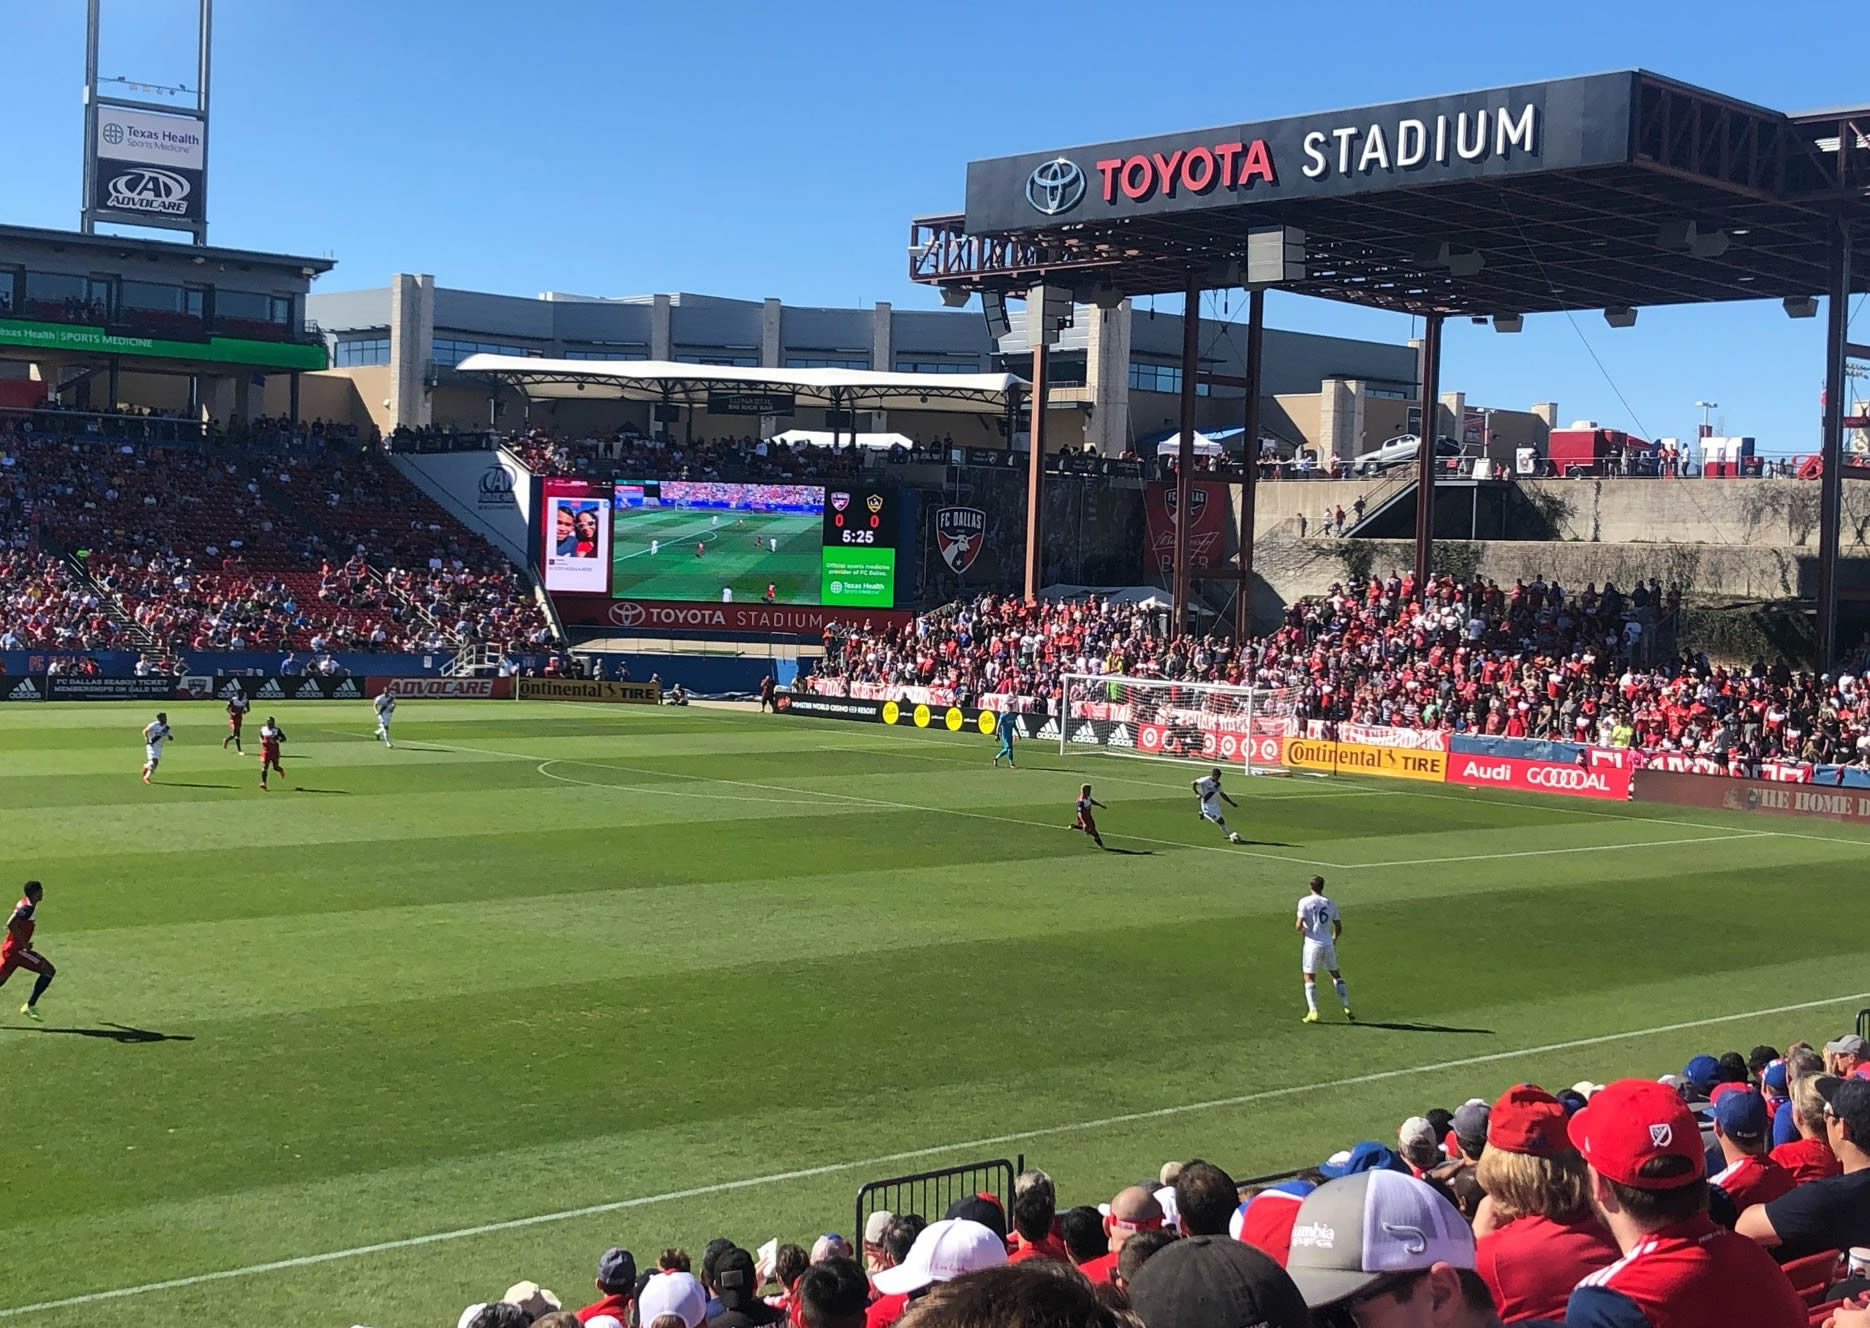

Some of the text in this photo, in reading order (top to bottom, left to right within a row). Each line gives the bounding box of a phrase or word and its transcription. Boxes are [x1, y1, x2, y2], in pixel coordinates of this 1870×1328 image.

[127, 126, 199, 145] Texas Health
[127, 138, 190, 154] Sports Medicine
[1096, 103, 1534, 201] TOYOTA STADIUM
[107, 195, 188, 214] ADVOCARE
[0, 329, 152, 348] exas Health SPORTS MEDICINE
[834, 513, 880, 529] 0 0
[941, 511, 982, 529] FC DALLAS
[841, 529, 874, 544] 5:25
[863, 582, 885, 590] Health
[649, 608, 823, 628] TOYOTA STADIUM
[9, 691, 41, 699] adidas
[256, 691, 285, 699] adidas
[295, 691, 324, 699] adidas
[332, 691, 360, 699] adidas
[389, 678, 493, 697] ADVOCARE
[515, 679, 655, 700] Continental TIRE
[1072, 734, 1099, 745] adidas
[1288, 740, 1441, 774] Continental TIRE
[1463, 761, 1511, 781] Audi
[1794, 791, 1853, 815] HOME
[1292, 1222, 1335, 1241] umbia
